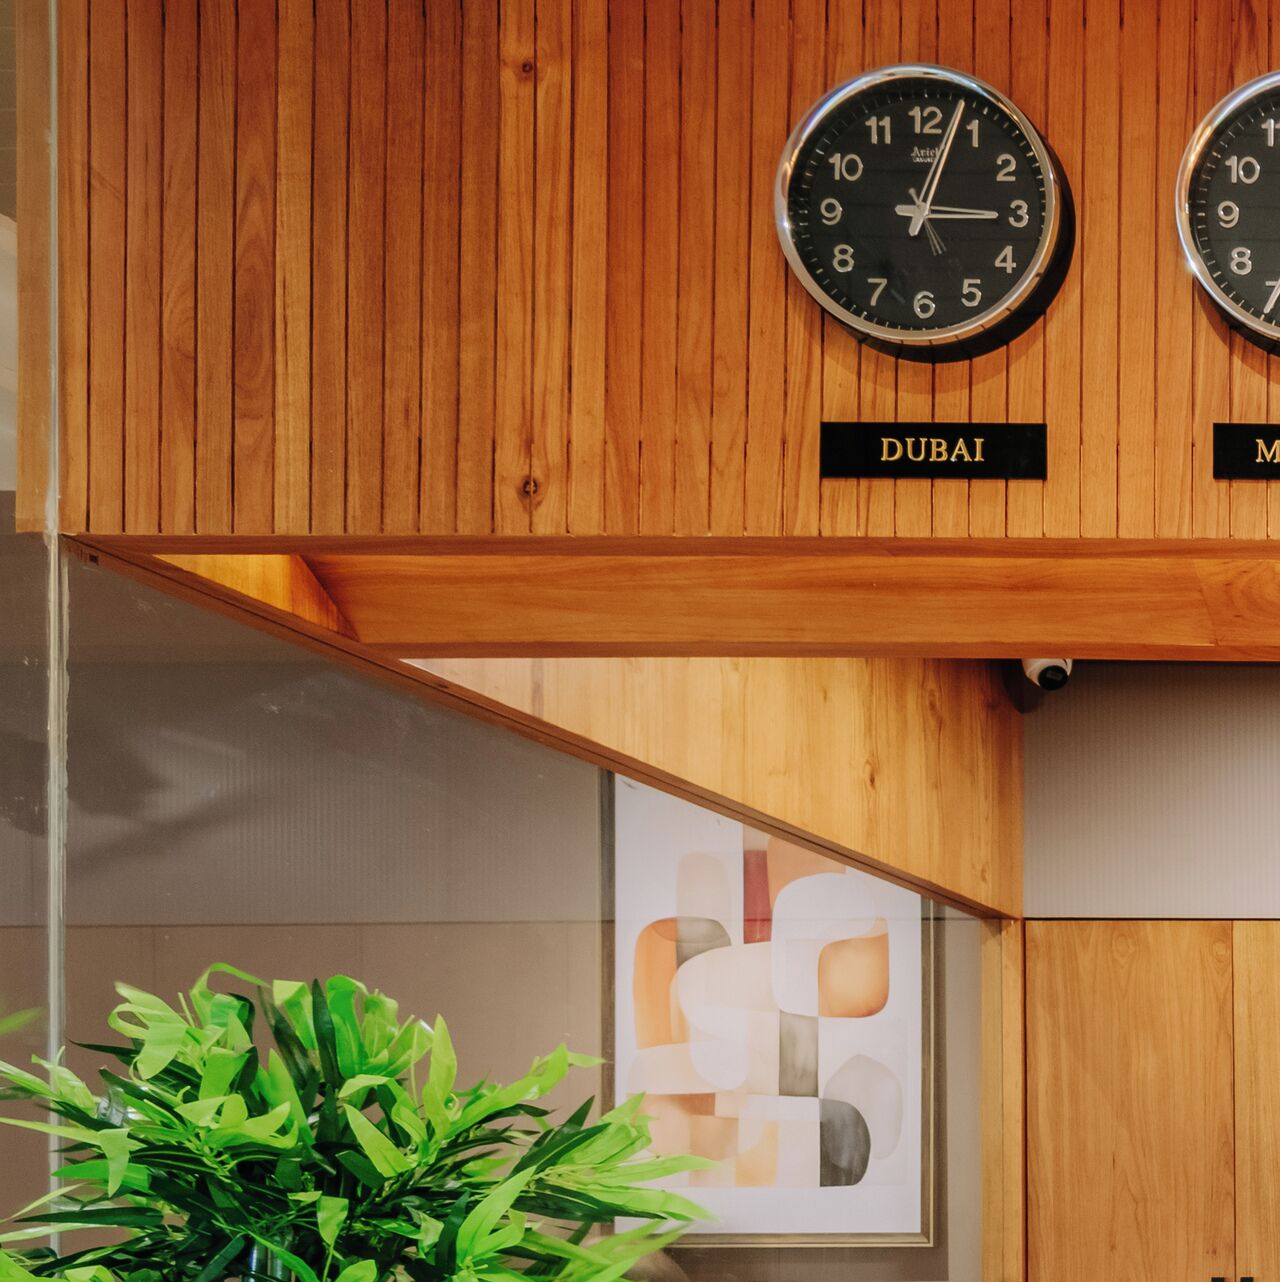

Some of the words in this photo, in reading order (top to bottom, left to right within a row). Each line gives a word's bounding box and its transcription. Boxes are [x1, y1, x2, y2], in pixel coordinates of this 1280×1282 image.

[865, 116, 891, 144] 11
[908, 106, 942, 134] 12
[966, 120, 978, 147] 1
[829, 153, 863, 181] 10
[996, 154, 1016, 181] 2
[1225, 156, 1260, 184] 10
[820, 198, 842, 225] 9
[1009, 200, 1028, 227] 3
[1218, 201, 1239, 228] 9
[833, 244, 854, 272] 8
[994, 246, 1016, 273] 4
[1230, 247, 1252, 275] 8
[868, 278, 887, 306] 7
[914, 291, 935, 319] 6
[961, 279, 982, 307] 5
[880, 437, 985, 463] DUBAI
